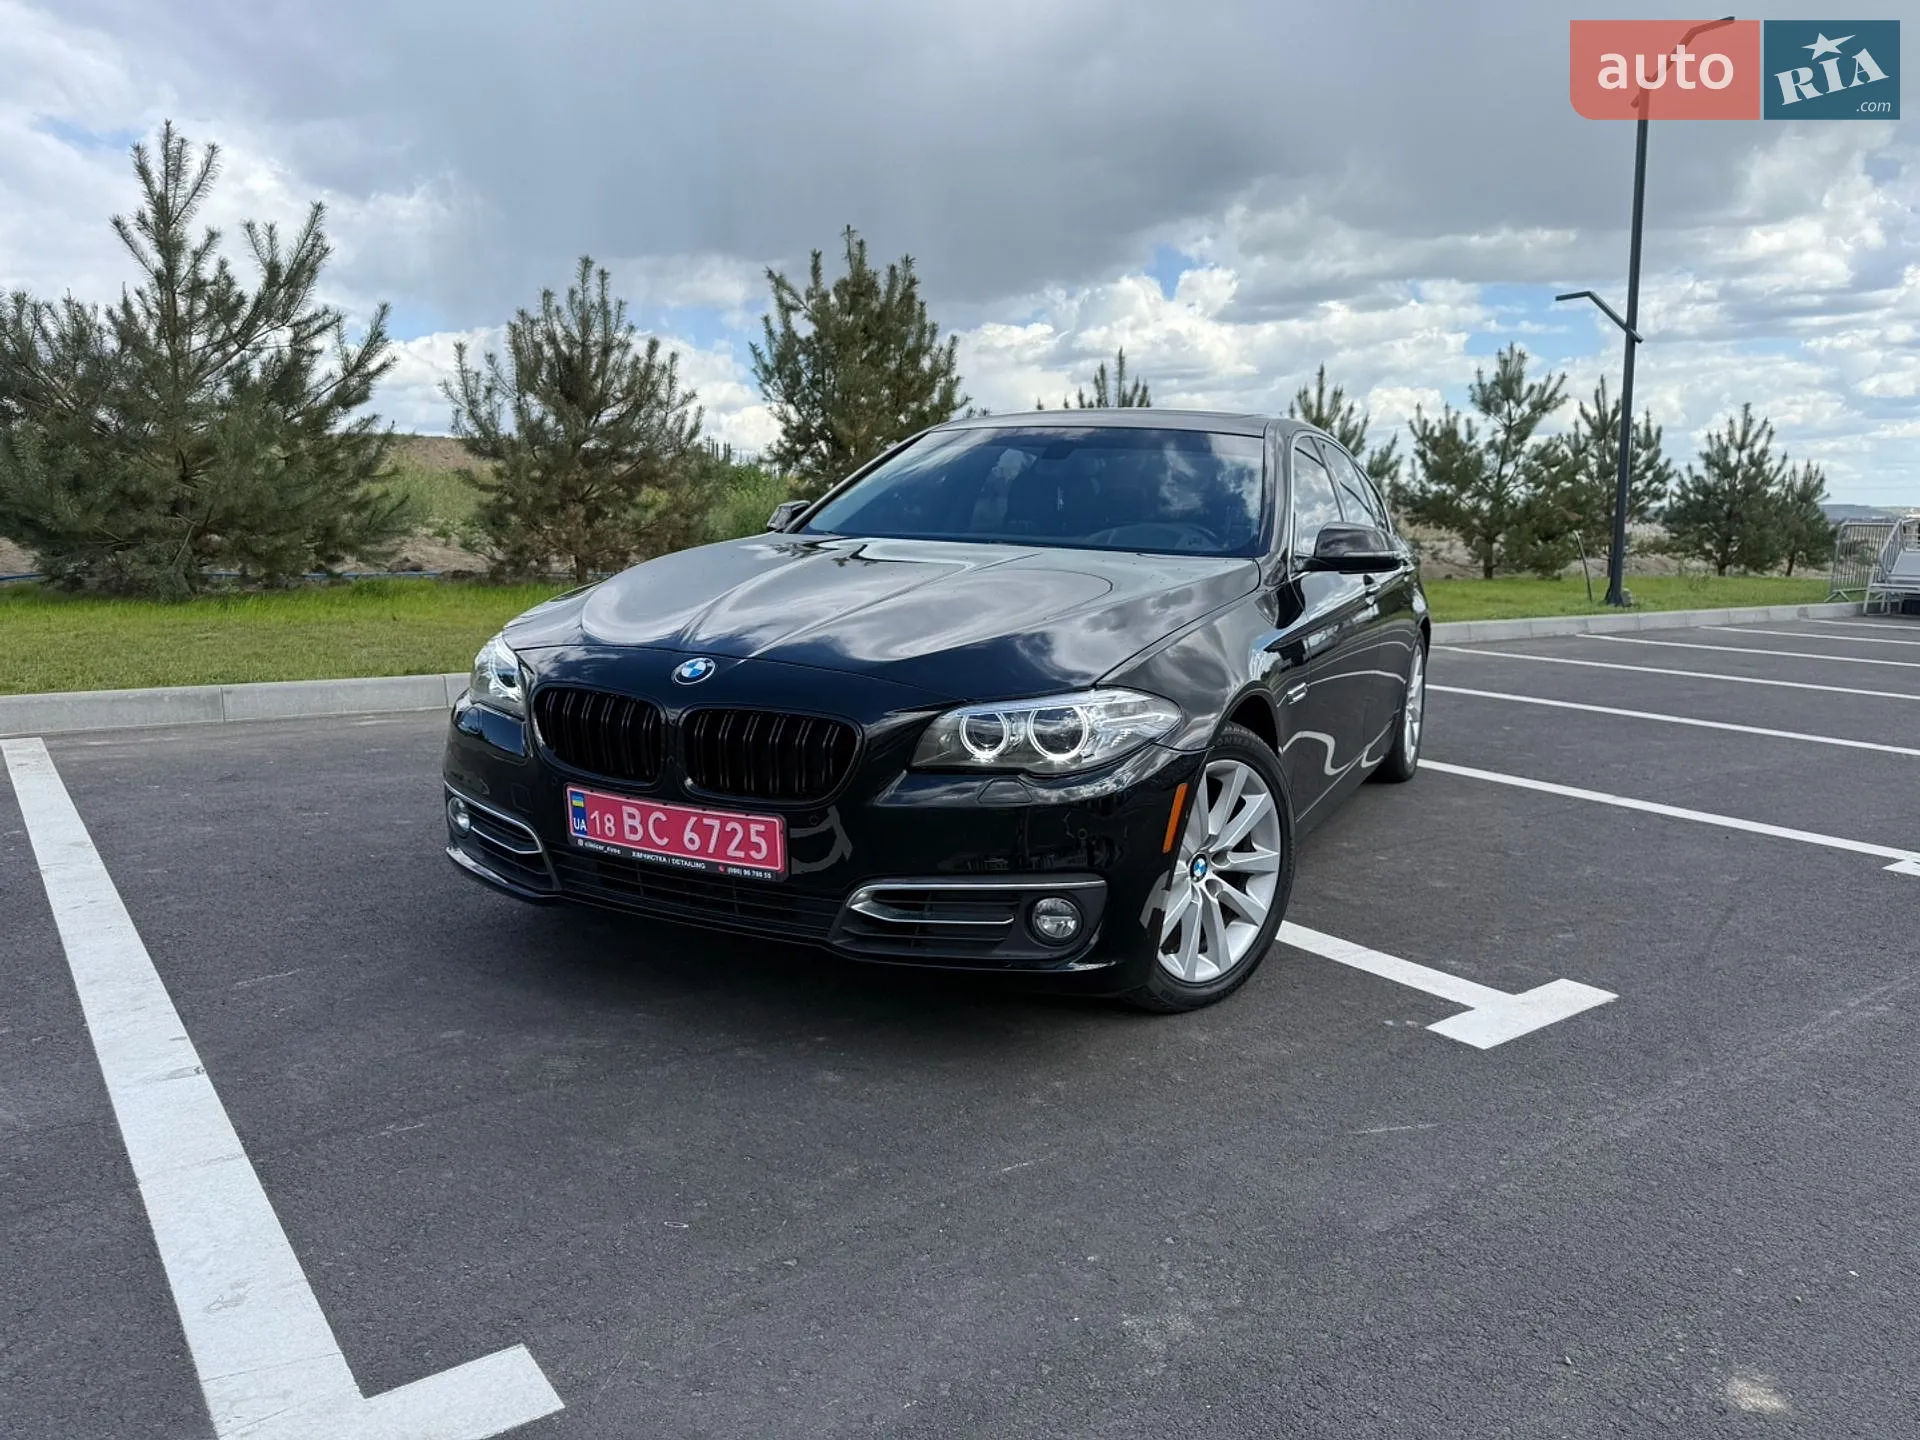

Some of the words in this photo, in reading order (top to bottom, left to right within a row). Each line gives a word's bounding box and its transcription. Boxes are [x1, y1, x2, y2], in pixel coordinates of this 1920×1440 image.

[574, 817, 587, 832] UA
[590, 809, 616, 838] 18
[621, 805, 670, 847] BC
[683, 816, 768, 861] 6725
